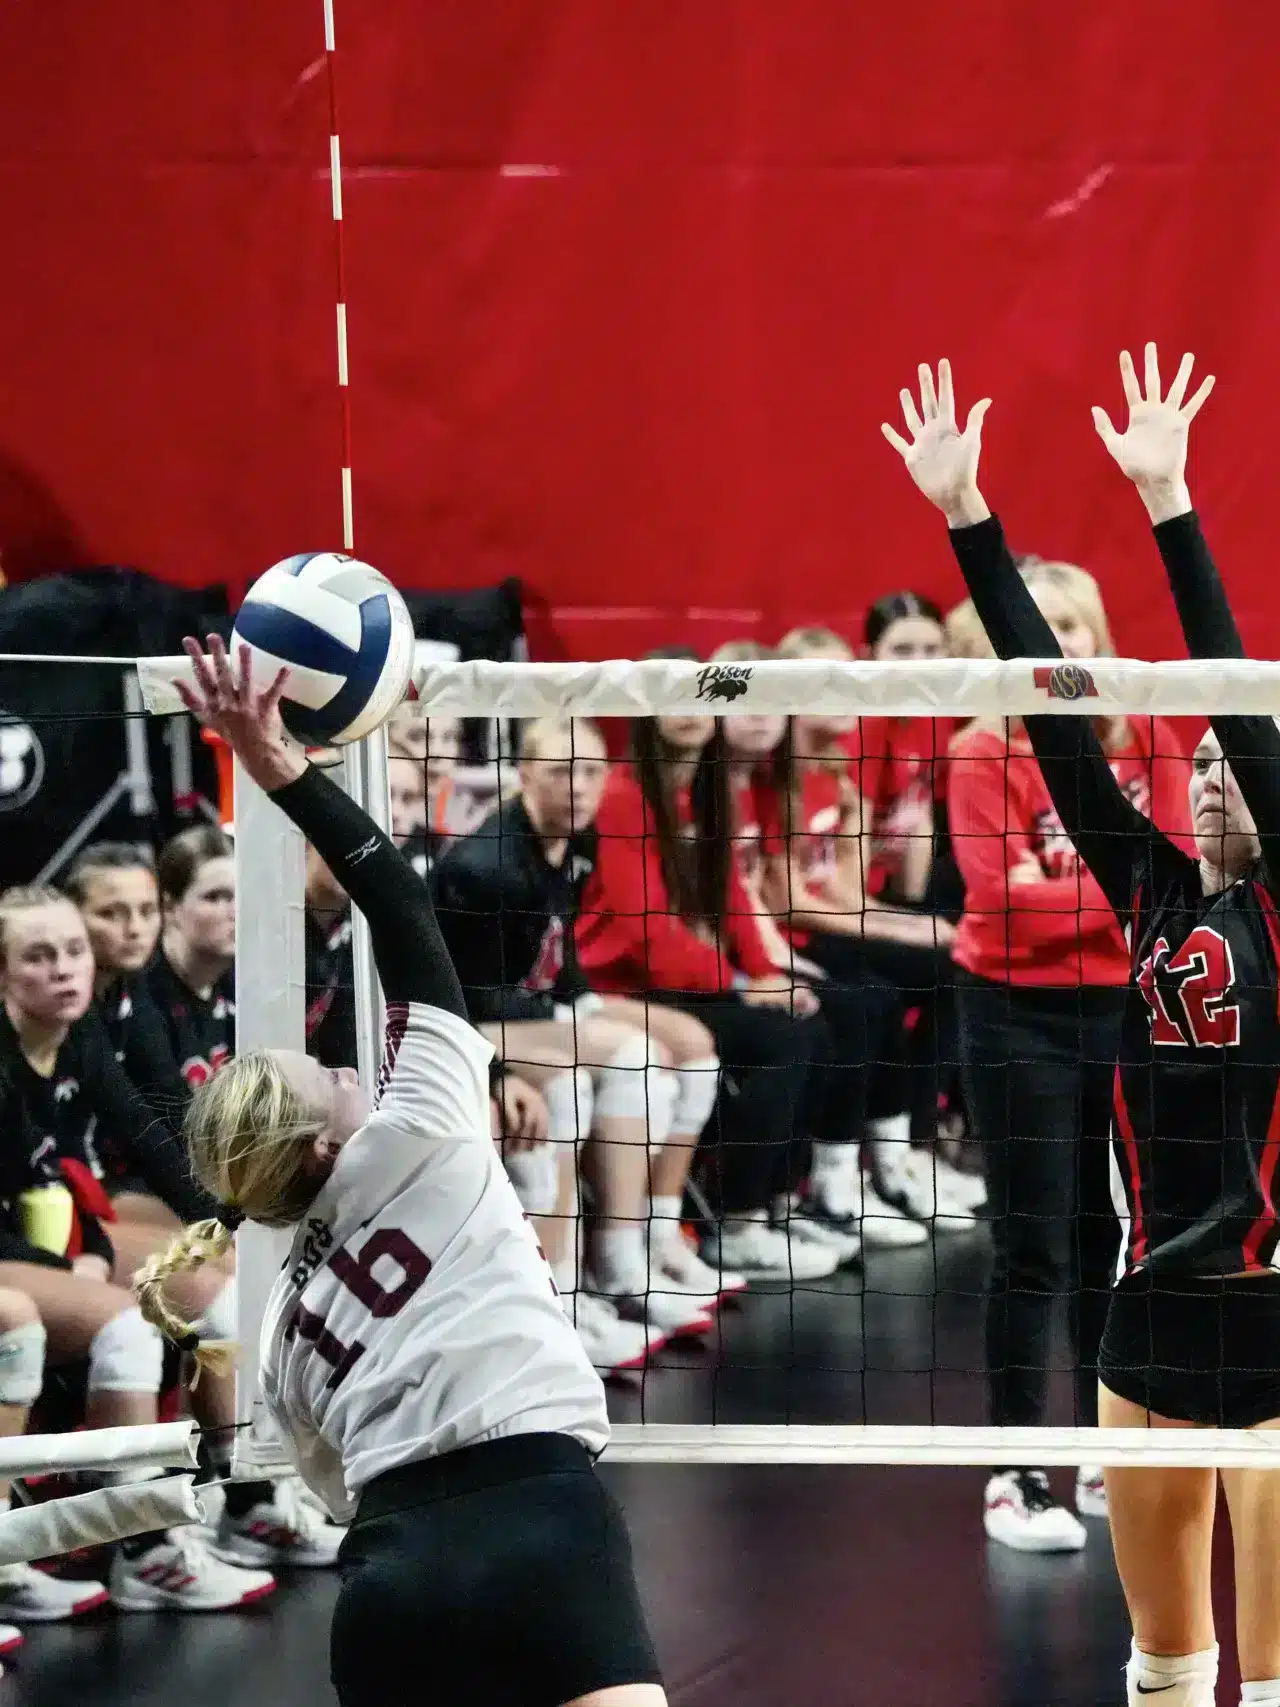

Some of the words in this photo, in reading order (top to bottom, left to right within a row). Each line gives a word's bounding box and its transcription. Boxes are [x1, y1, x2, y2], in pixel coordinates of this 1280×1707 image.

[694, 665, 756, 699] Bison
[1136, 926, 1241, 1049] 12
[285, 1227, 433, 1390] 16
